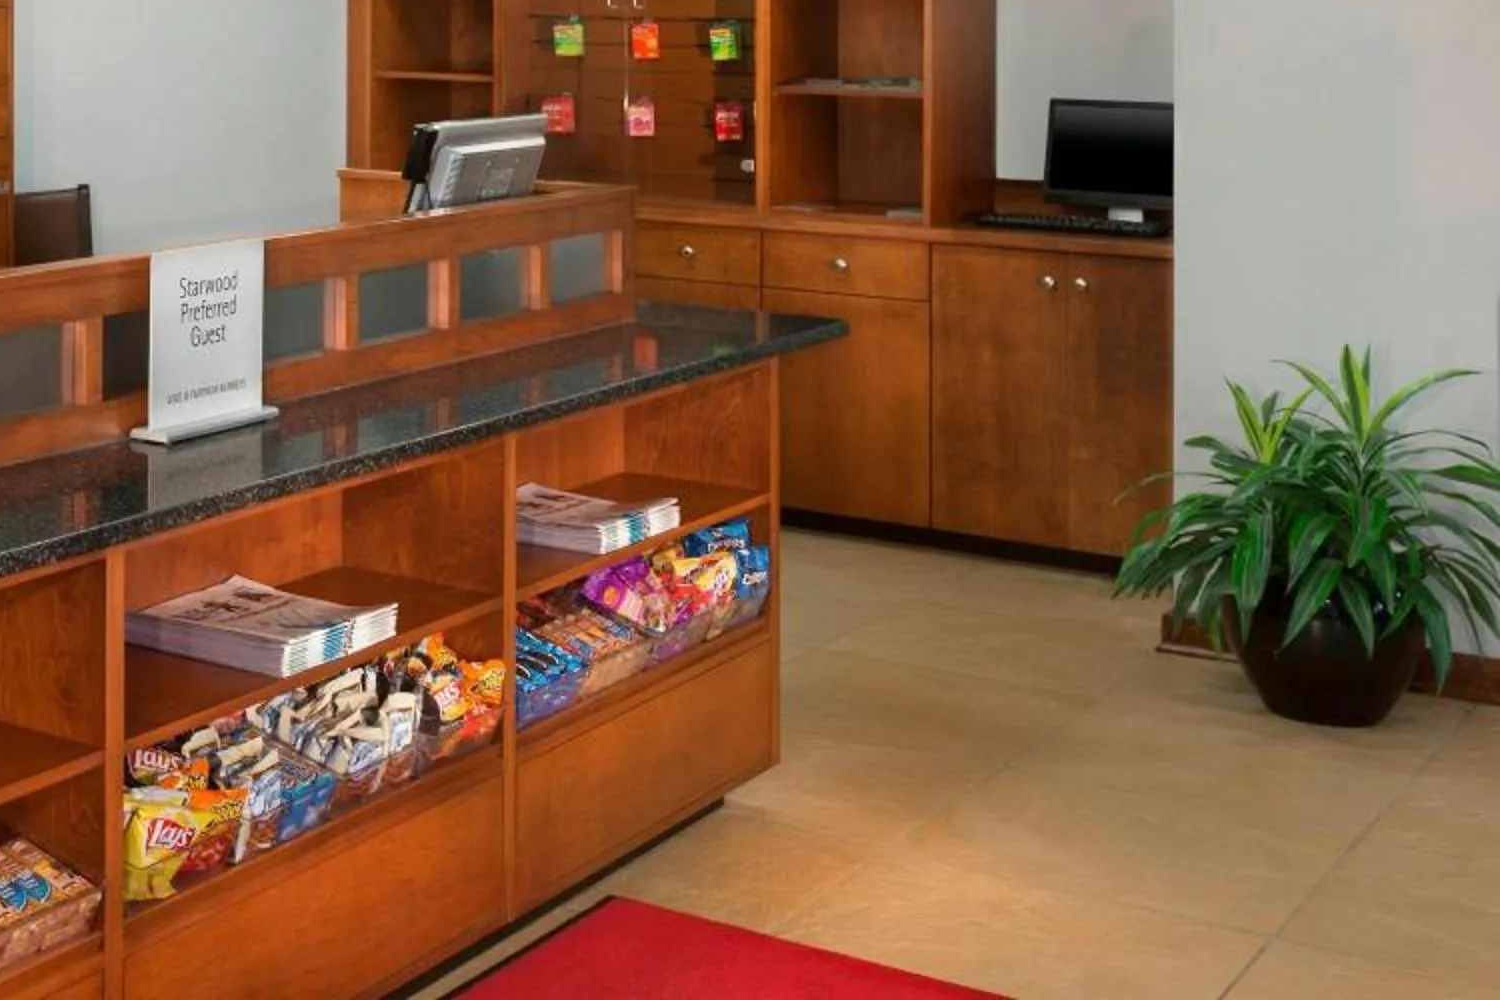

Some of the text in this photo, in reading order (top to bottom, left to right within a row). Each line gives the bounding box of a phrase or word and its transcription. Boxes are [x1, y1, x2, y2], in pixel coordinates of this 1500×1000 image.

[179, 271, 240, 299] Starwood
[181, 294, 238, 323] Preferred
[190, 324, 227, 348] Guest
